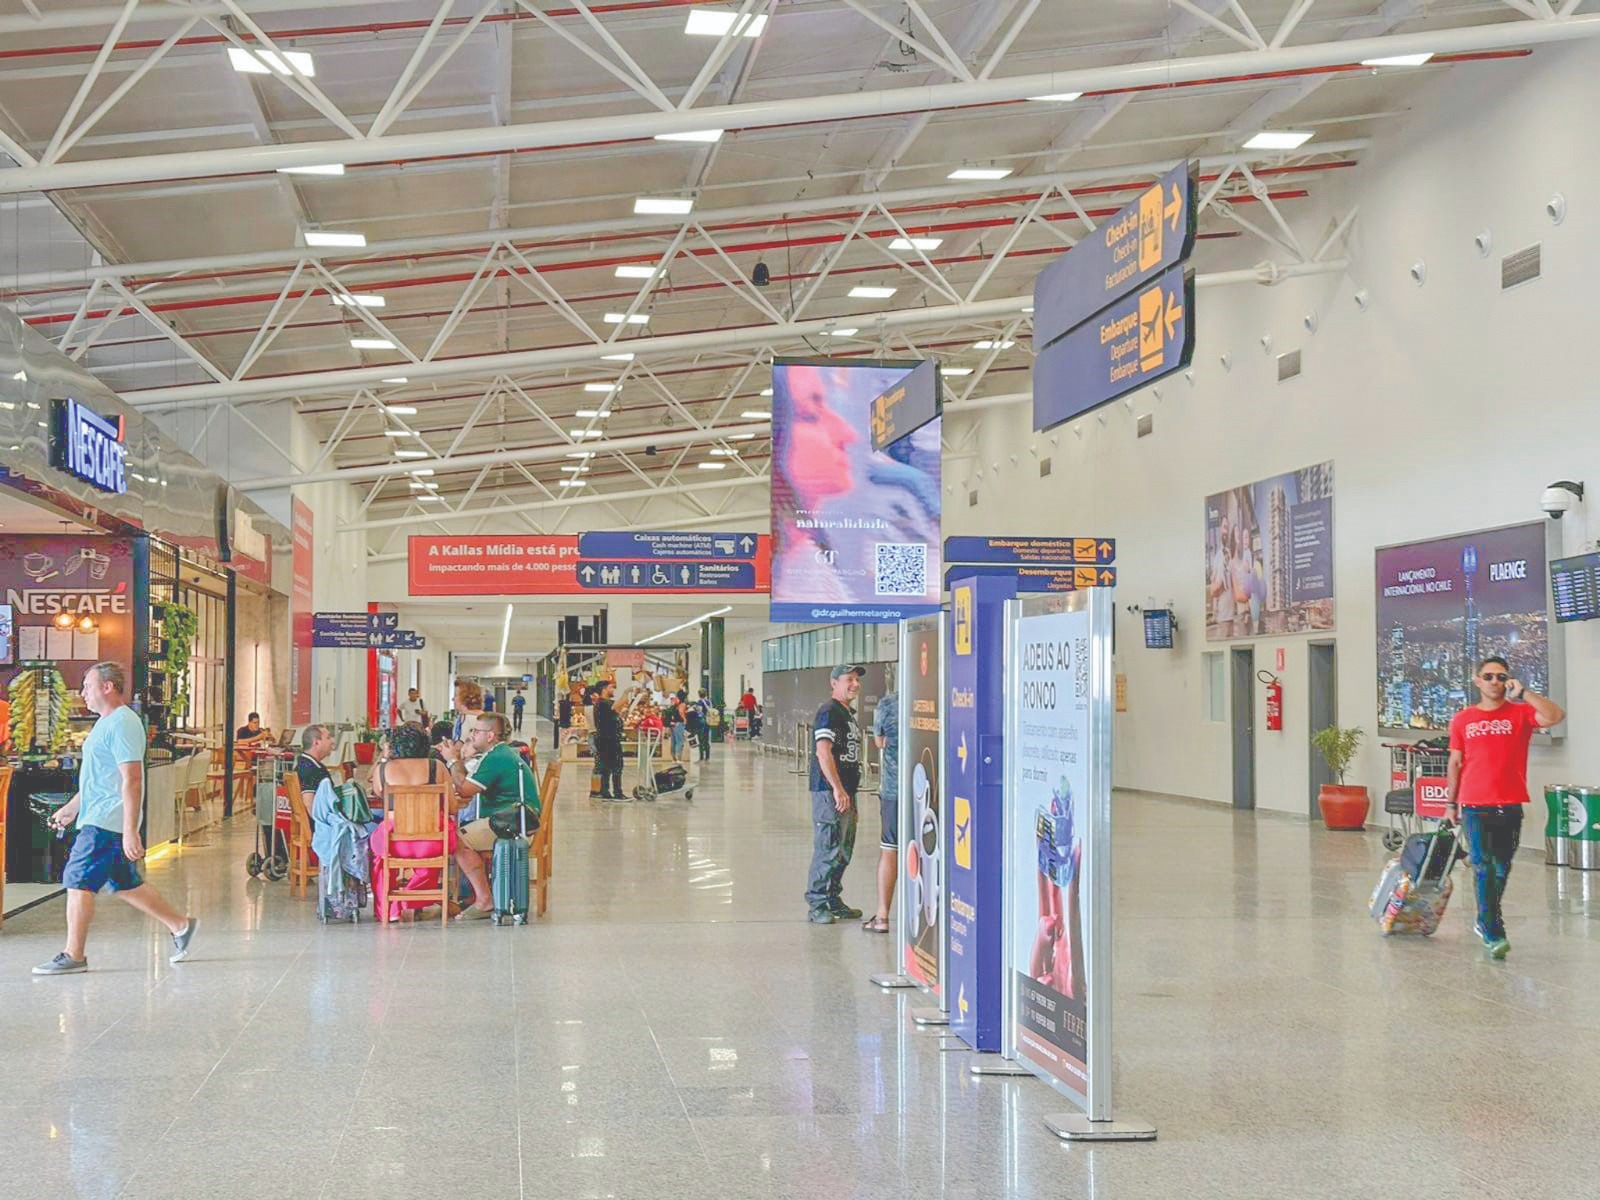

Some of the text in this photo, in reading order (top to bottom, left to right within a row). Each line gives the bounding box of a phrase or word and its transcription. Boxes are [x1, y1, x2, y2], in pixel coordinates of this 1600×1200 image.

[1106, 212, 1137, 247] Check-in
[1101, 312, 1137, 344] Embarque
[68, 398, 128, 494] NESCAFÉ
[634, 534, 711, 542] Caixas automáticos
[988, 540, 1071, 548] Embarque doméstico
[428, 545, 439, 556] A
[442, 545, 483, 556] Kallas
[486, 543, 525, 556] Mídia
[527, 543, 556, 556] está
[487, 563, 509, 571] mais
[511, 563, 524, 571] de
[525, 563, 549, 571] 4.000
[699, 564, 739, 572] Sanitários
[1018, 568, 1072, 577] Desembarque
[1398, 567, 1436, 583] LANÇAMENTO
[1490, 560, 1526, 581] PLAENGE
[1384, 584, 1425, 597] INTERNACIONAL
[1434, 580, 1452, 592] CHILE
[7, 581, 128, 615] NESCAFÉ
[811, 608, 901, 618] @dr.guilhermetargino
[1022, 641, 1070, 671] ADEUS AO
[1023, 681, 1056, 710] RONCO
